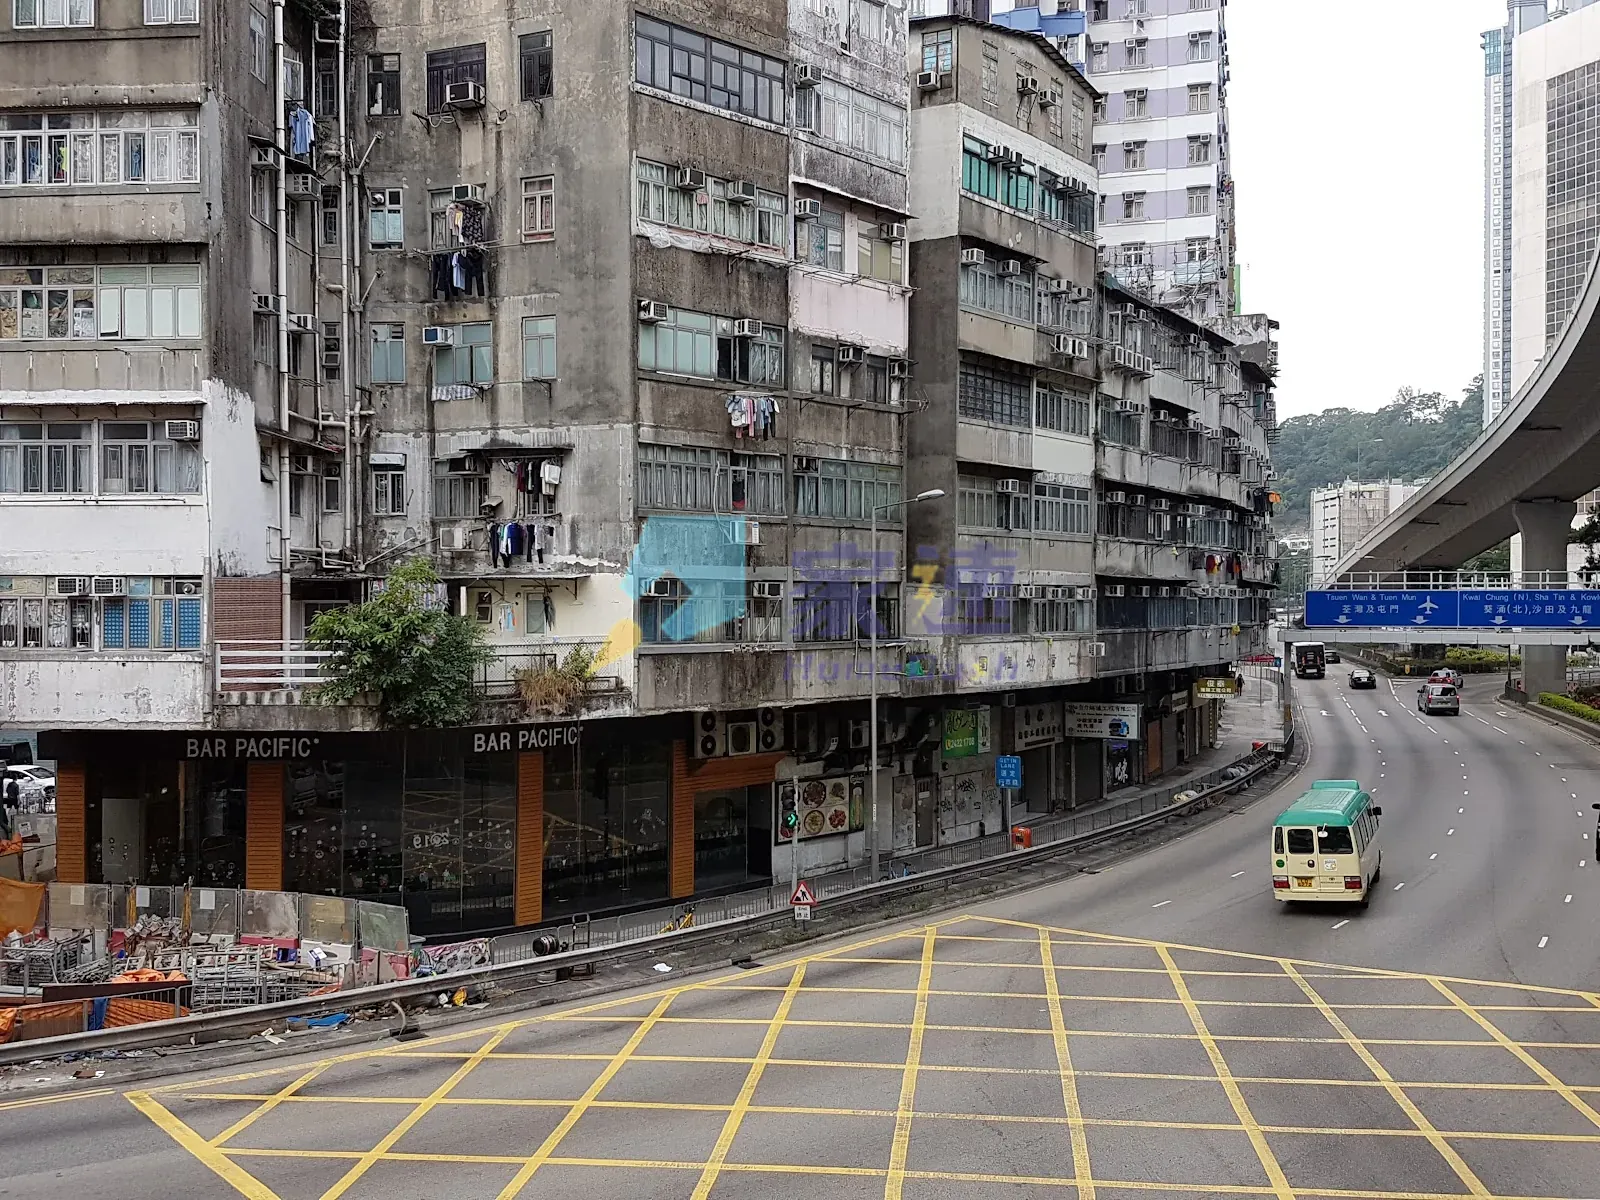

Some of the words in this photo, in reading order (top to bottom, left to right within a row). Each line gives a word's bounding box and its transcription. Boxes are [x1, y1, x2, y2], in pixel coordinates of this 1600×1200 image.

[1325, 593, 1348, 601] Tsuen
[1351, 593, 1368, 601] Wan
[1370, 593, 1377, 601] &
[1379, 593, 1398, 601] Tuen
[1401, 593, 1417, 601] Mun
[1462, 593, 1481, 601] Kwai
[1485, 593, 1509, 602] Chung
[1534, 593, 1549, 601] Sha
[1553, 593, 1565, 601] Tin
[1570, 593, 1577, 601] &
[1342, 604, 1399, 614] 荃灣及屯門
[473, 731, 511, 753] BAR
[518, 726, 578, 750] PACIFIC
[187, 738, 227, 758] BAR
[235, 738, 311, 758] PACIFIC
